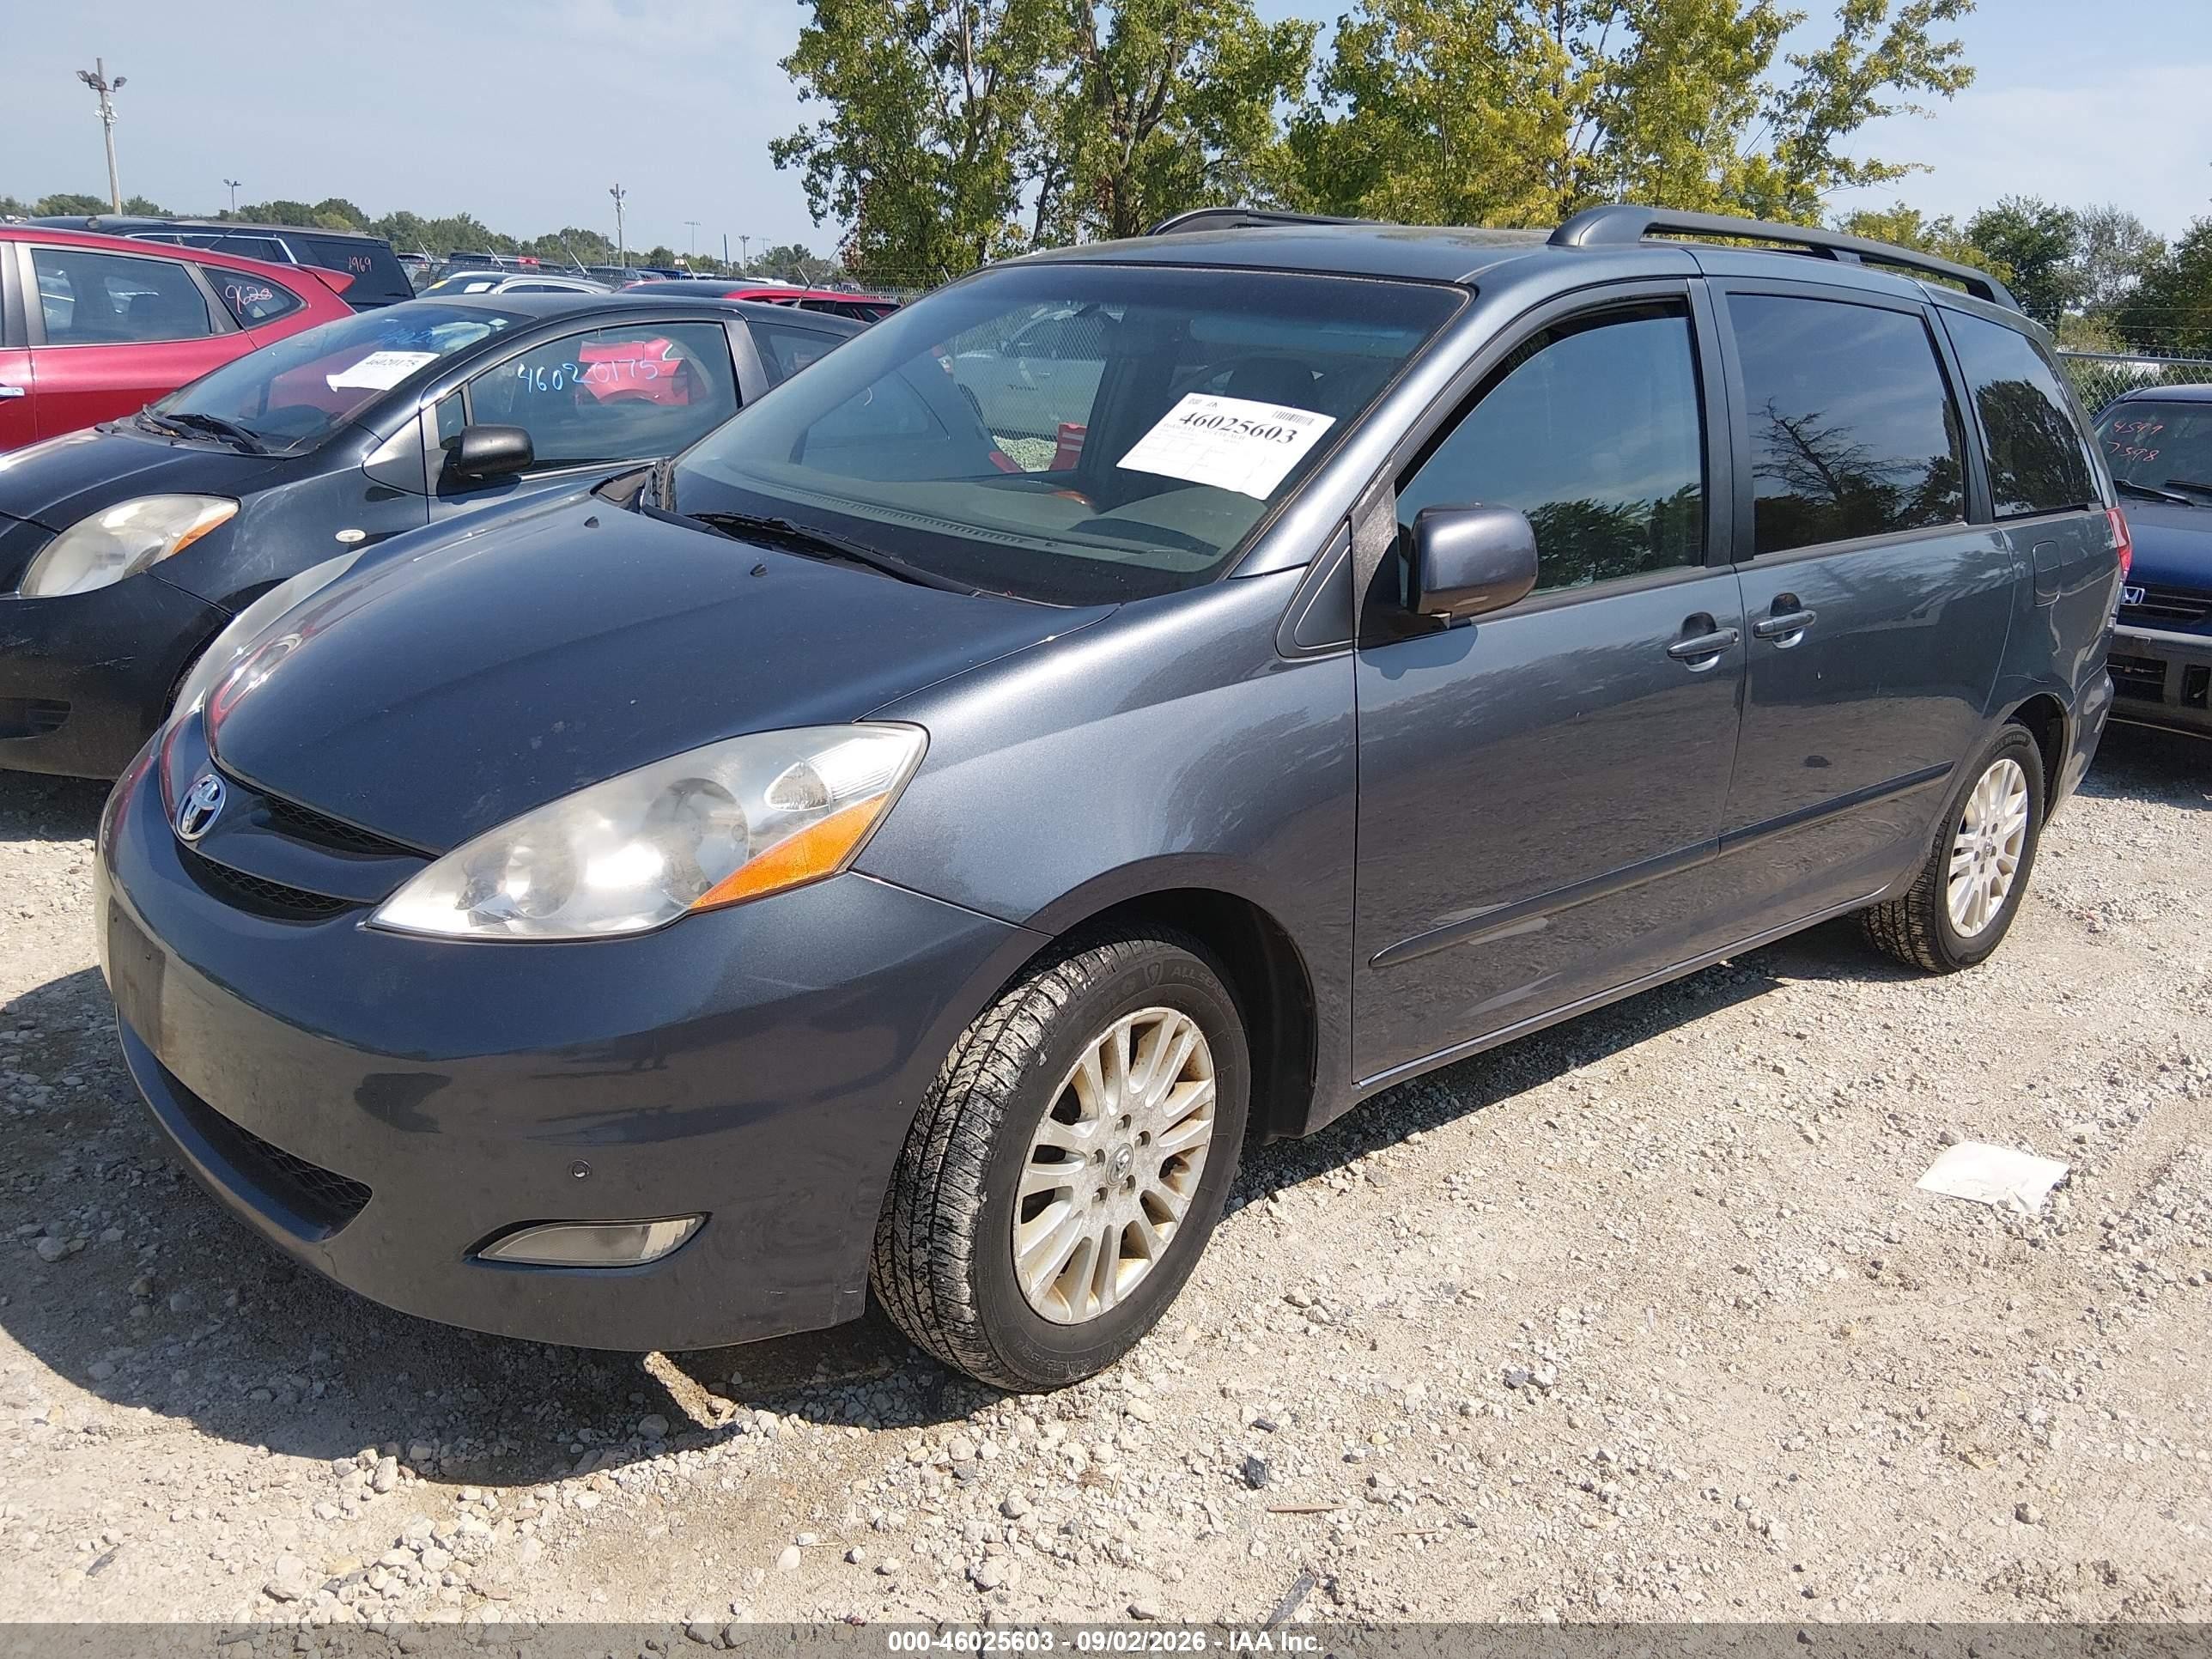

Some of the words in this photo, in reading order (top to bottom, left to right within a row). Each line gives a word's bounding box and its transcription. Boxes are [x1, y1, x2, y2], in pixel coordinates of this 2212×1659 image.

[349, 256, 372, 272] 1969
[517, 359, 659, 393] 46020175
[1179, 411, 1298, 445] 46025603
